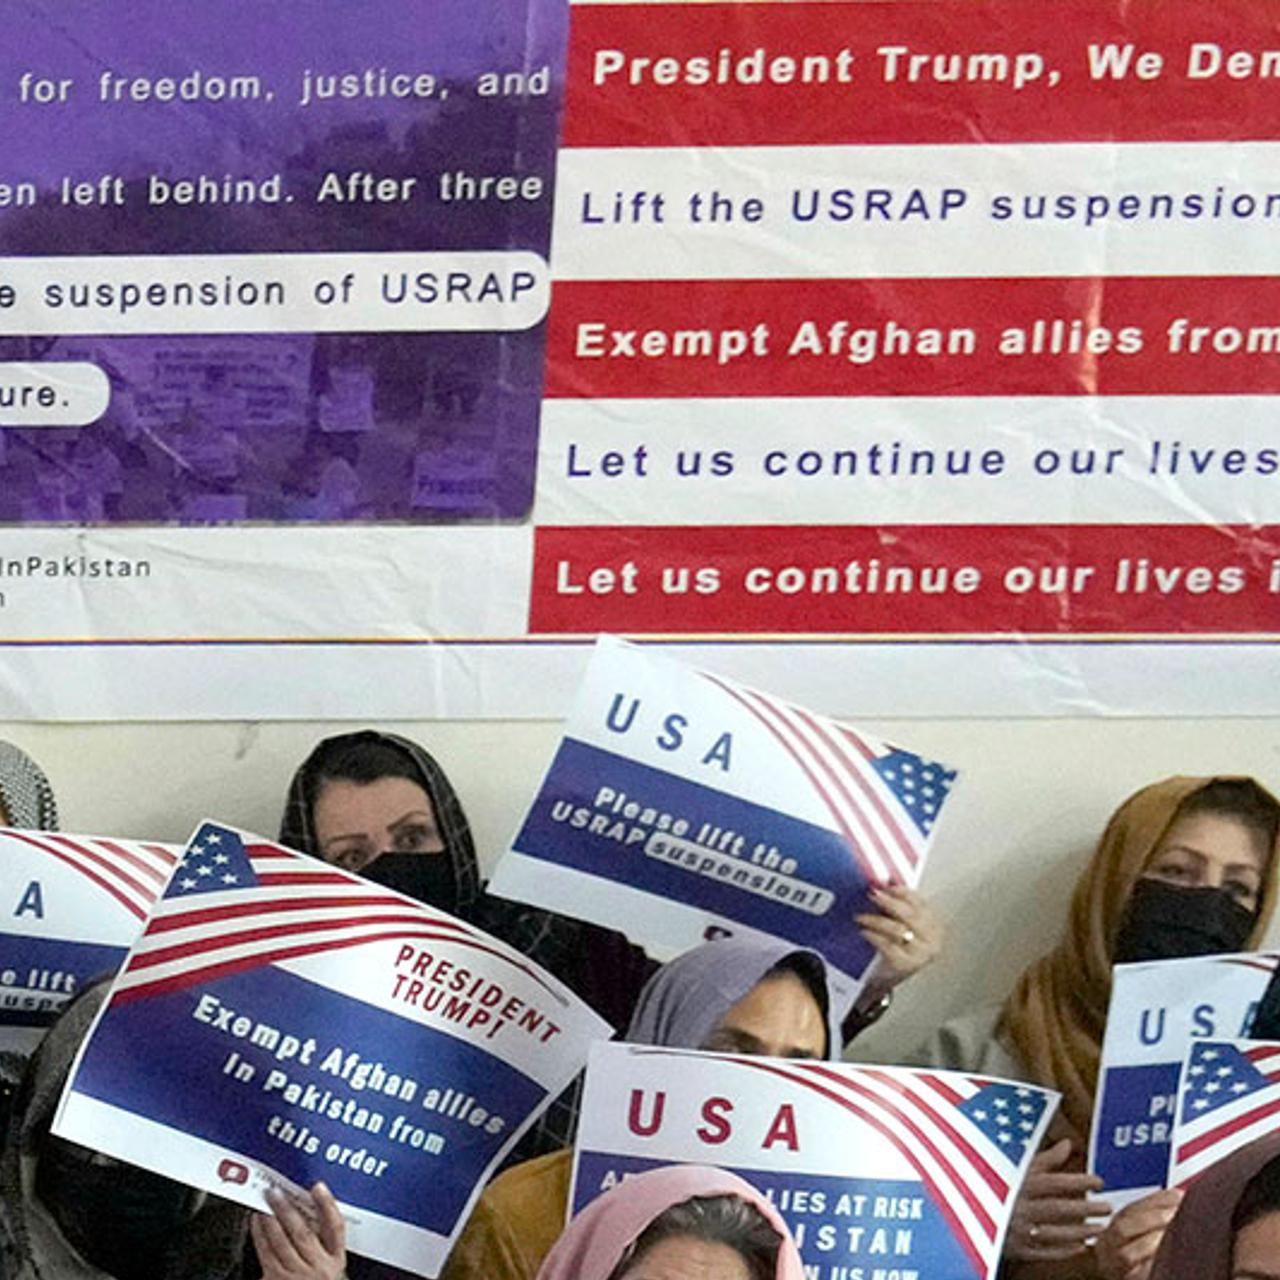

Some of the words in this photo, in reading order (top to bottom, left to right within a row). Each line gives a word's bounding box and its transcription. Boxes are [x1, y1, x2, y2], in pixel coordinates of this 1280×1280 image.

[20, 73, 72, 102] for
[100, 71, 273, 100] freedom,
[300, 68, 447, 105] justice,
[479, 66, 549, 95] and
[595, 49, 853, 84] President
[877, 47, 1059, 88] Trump,
[1088, 43, 1163, 80] We
[62, 175, 123, 205] left
[150, 174, 293, 203] behind.
[318, 172, 416, 201] After
[441, 172, 542, 200] three
[582, 192, 664, 223] Lift
[690, 192, 763, 222] the
[793, 189, 966, 221] USRAP
[992, 187, 1280, 226] suspension
[46, 276, 284, 313] suspension
[315, 274, 354, 304] of
[383, 272, 535, 303] USRAP
[577, 324, 768, 363] Exempt
[789, 322, 975, 363] Afghan
[1000, 321, 1141, 353] allies
[1168, 319, 1280, 352] from
[558, 561, 637, 593] Let
[662, 567, 719, 593] us
[746, 560, 980, 593] continue
[1005, 566, 1094, 592] our
[1117, 559, 1243, 592] lives
[595, 786, 689, 838] Please
[551, 801, 646, 848] USRAP
[652, 839, 823, 908] suspension!
[391, 973, 502, 1040] TRUMP!
[395, 944, 561, 1045] PRESIDENT
[194, 994, 317, 1068] Exempt
[320, 1046, 417, 1112] Afghan
[422, 1082, 505, 1135] allies
[265, 1068, 383, 1134] Pakistan
[392, 1113, 445, 1155] from
[268, 1116, 318, 1151] this
[326, 1140, 388, 1179] order
[874, 1195, 923, 1220] RISK
